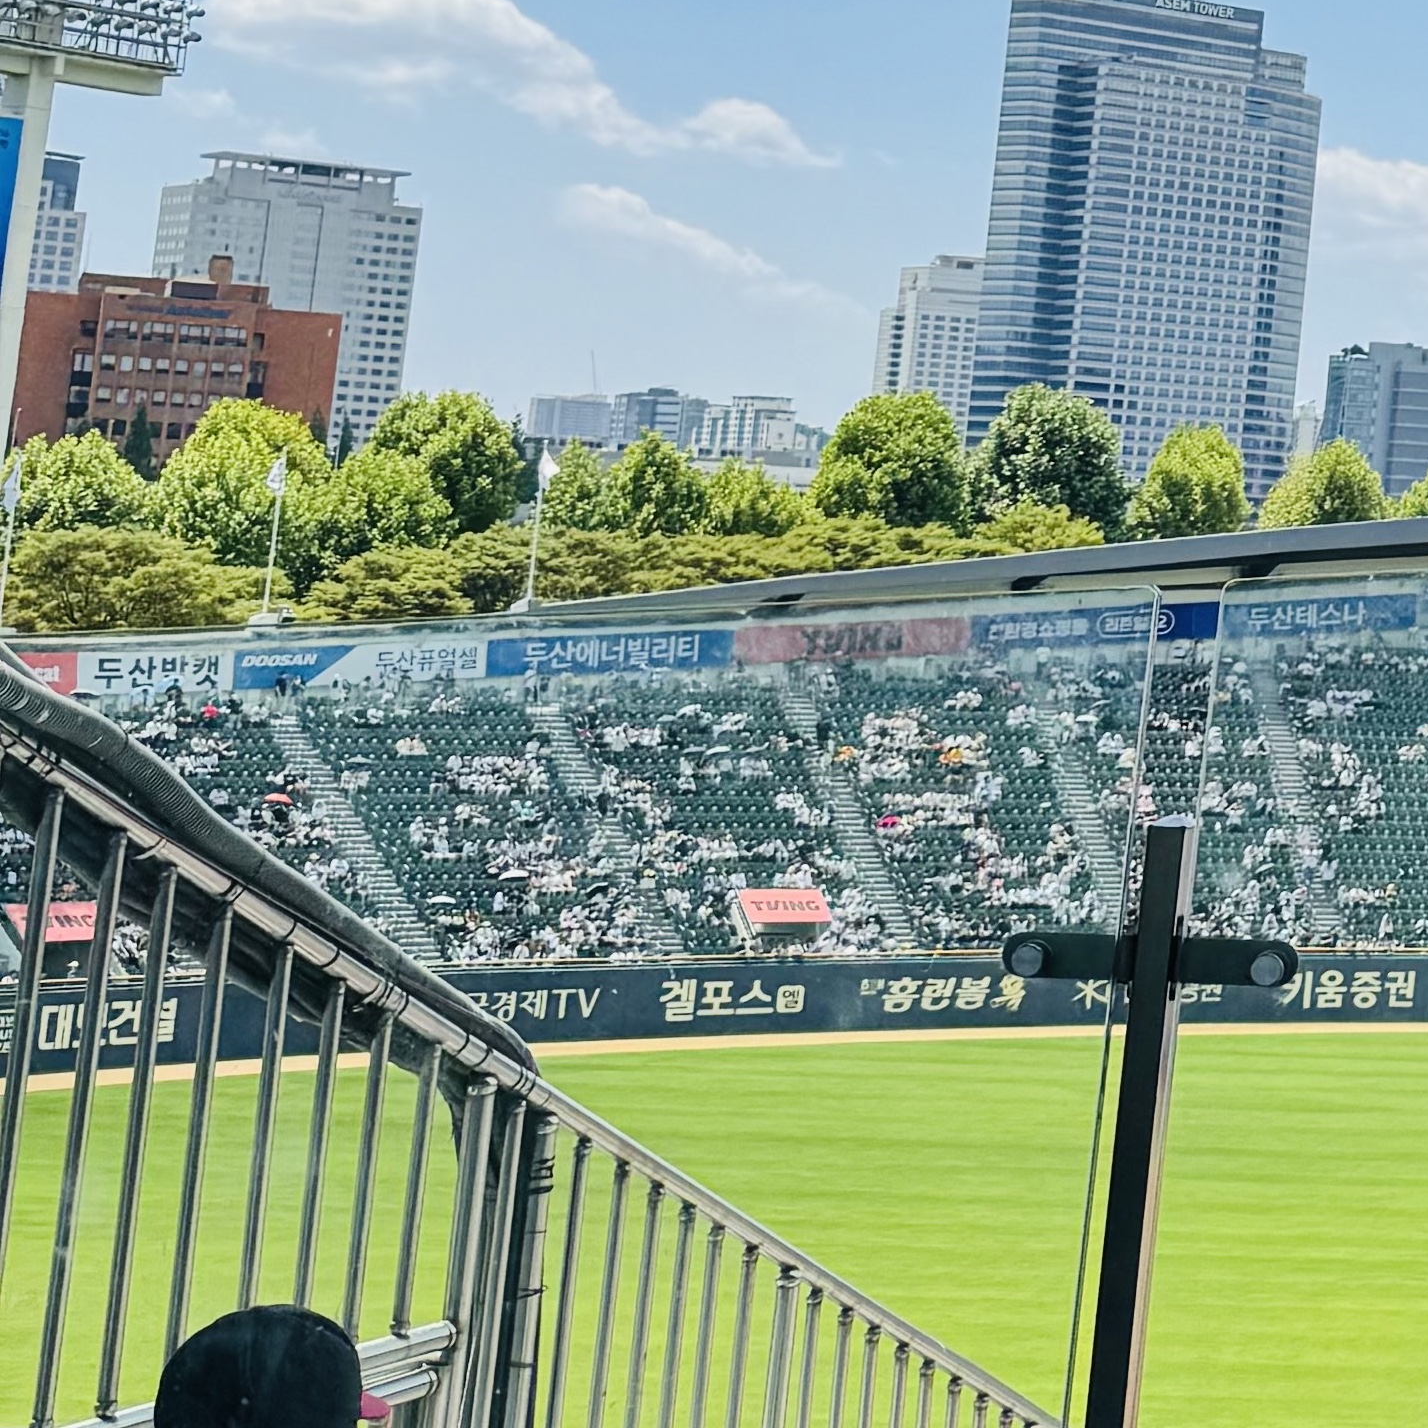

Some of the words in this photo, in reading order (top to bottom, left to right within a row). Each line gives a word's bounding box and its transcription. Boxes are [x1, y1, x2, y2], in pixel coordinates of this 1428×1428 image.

[1193, 1, 1235, 19] TOWER
[1248, 600, 1367, 628] 두산테스나
[241, 652, 317, 668] DOOSAN
[376, 645, 478, 672] 두산퓨얼셀
[522, 633, 701, 669] 두산에너빌리티
[750, 900, 821, 912] TVING
[881, 976, 991, 1013] 홈런볼
[1280, 970, 1417, 1010] 키움증권
[467, 987, 600, 1023] 국경제TV
